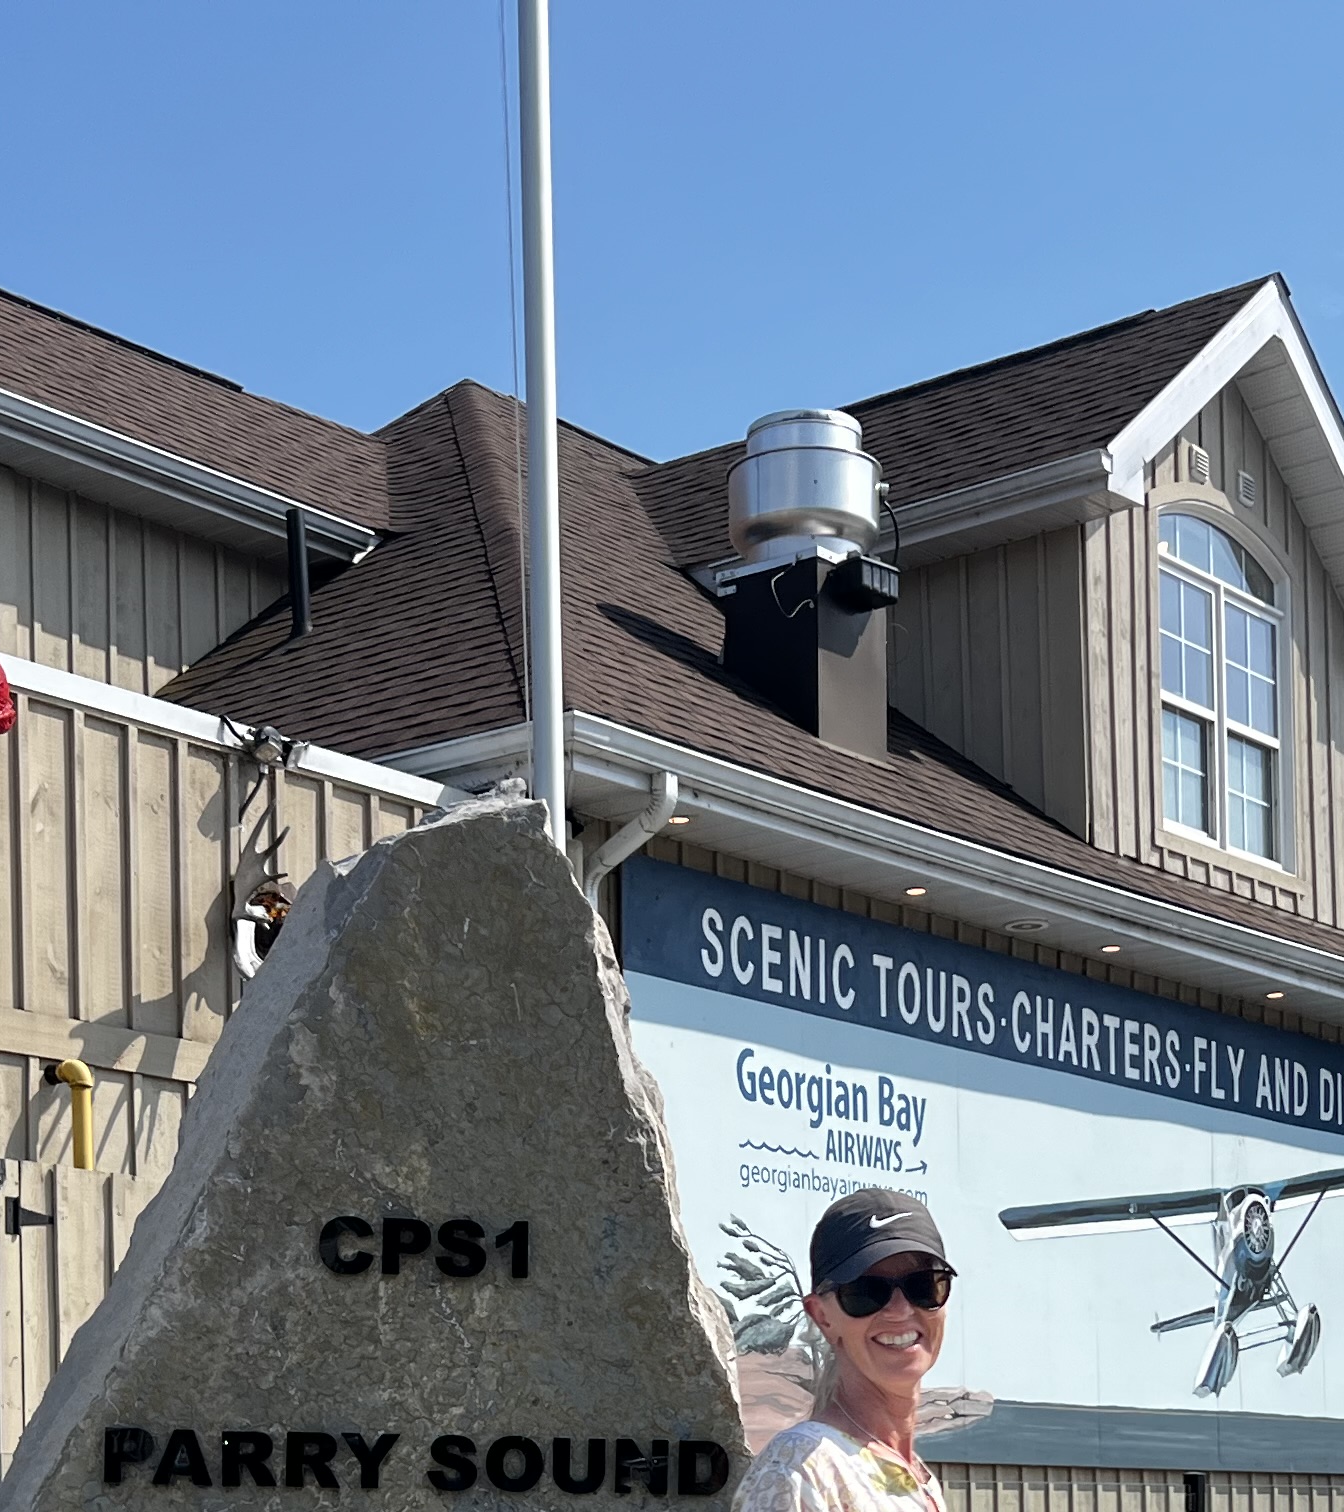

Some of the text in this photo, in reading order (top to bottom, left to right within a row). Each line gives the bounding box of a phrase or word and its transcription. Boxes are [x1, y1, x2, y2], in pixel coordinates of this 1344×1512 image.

[700, 907, 856, 1010] SCENIC
[1255, 1053, 1309, 1117] AND
[736, 1047, 927, 1147] Georgian Bay
[825, 1129, 903, 1173] AIRWAYS
[317, 1215, 530, 1280] CPS1
[103, 1427, 730, 1496] PARRY SOUND
